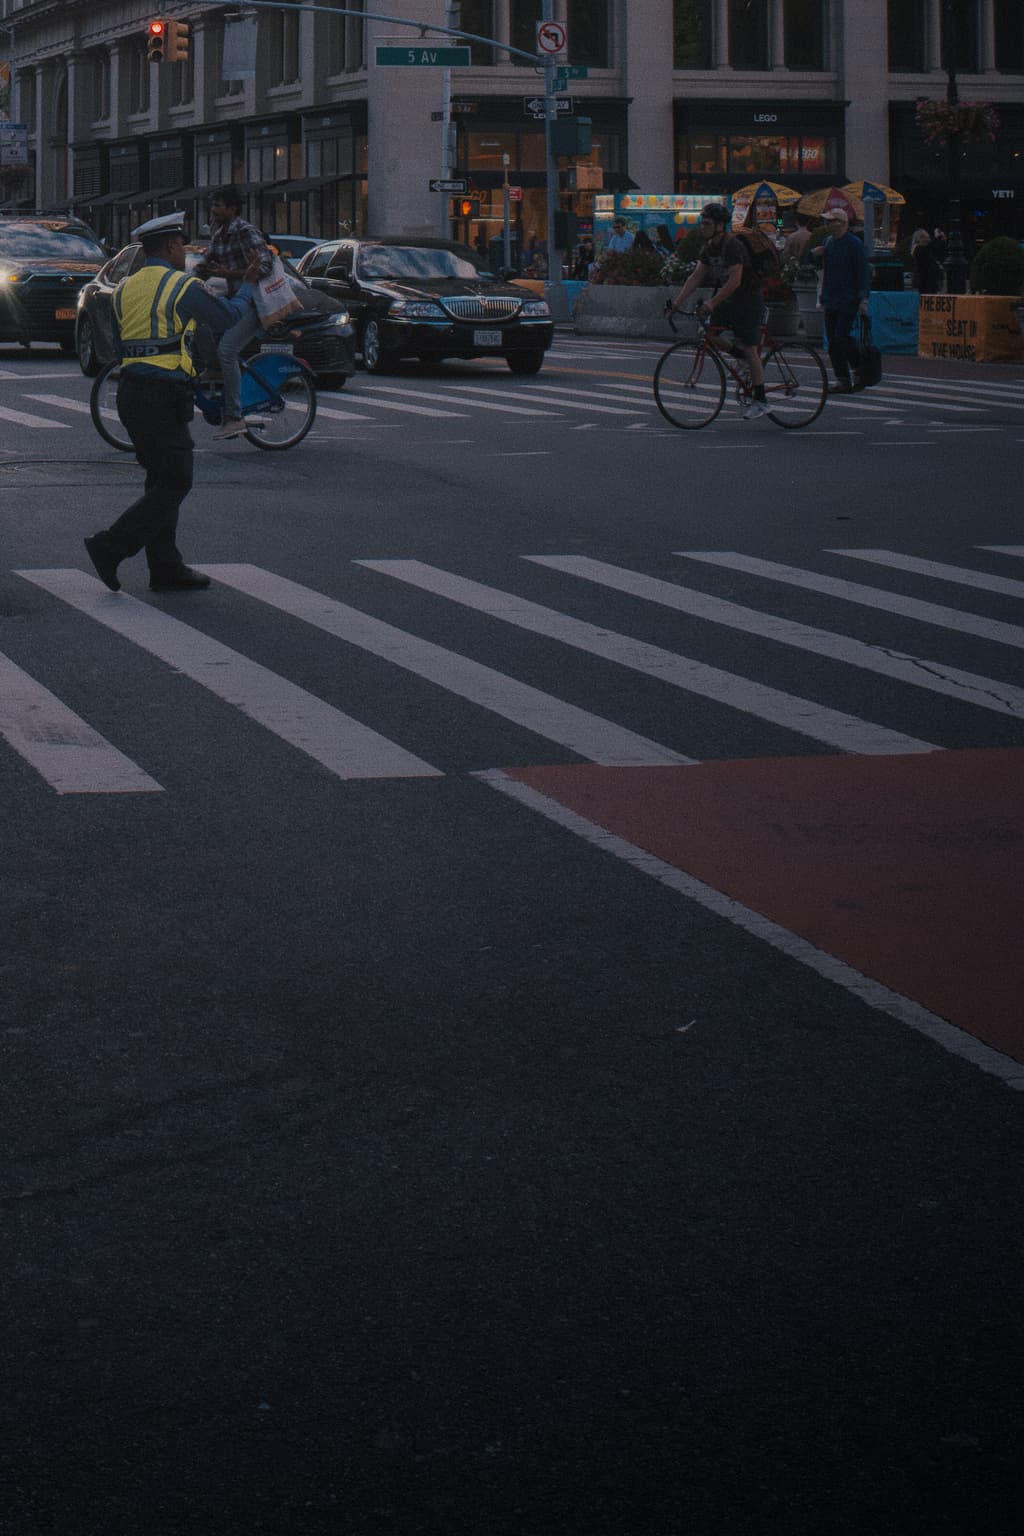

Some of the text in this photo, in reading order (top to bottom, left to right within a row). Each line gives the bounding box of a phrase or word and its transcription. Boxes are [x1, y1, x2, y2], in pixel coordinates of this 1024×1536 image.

[408, 51, 438, 63] 5 Av
[754, 114, 777, 122] LEGO
[992, 190, 1015, 199] YETI
[920, 296, 957, 315] THE BEST
[947, 319, 968, 338] SEAT
[932, 342, 948, 358] THE
